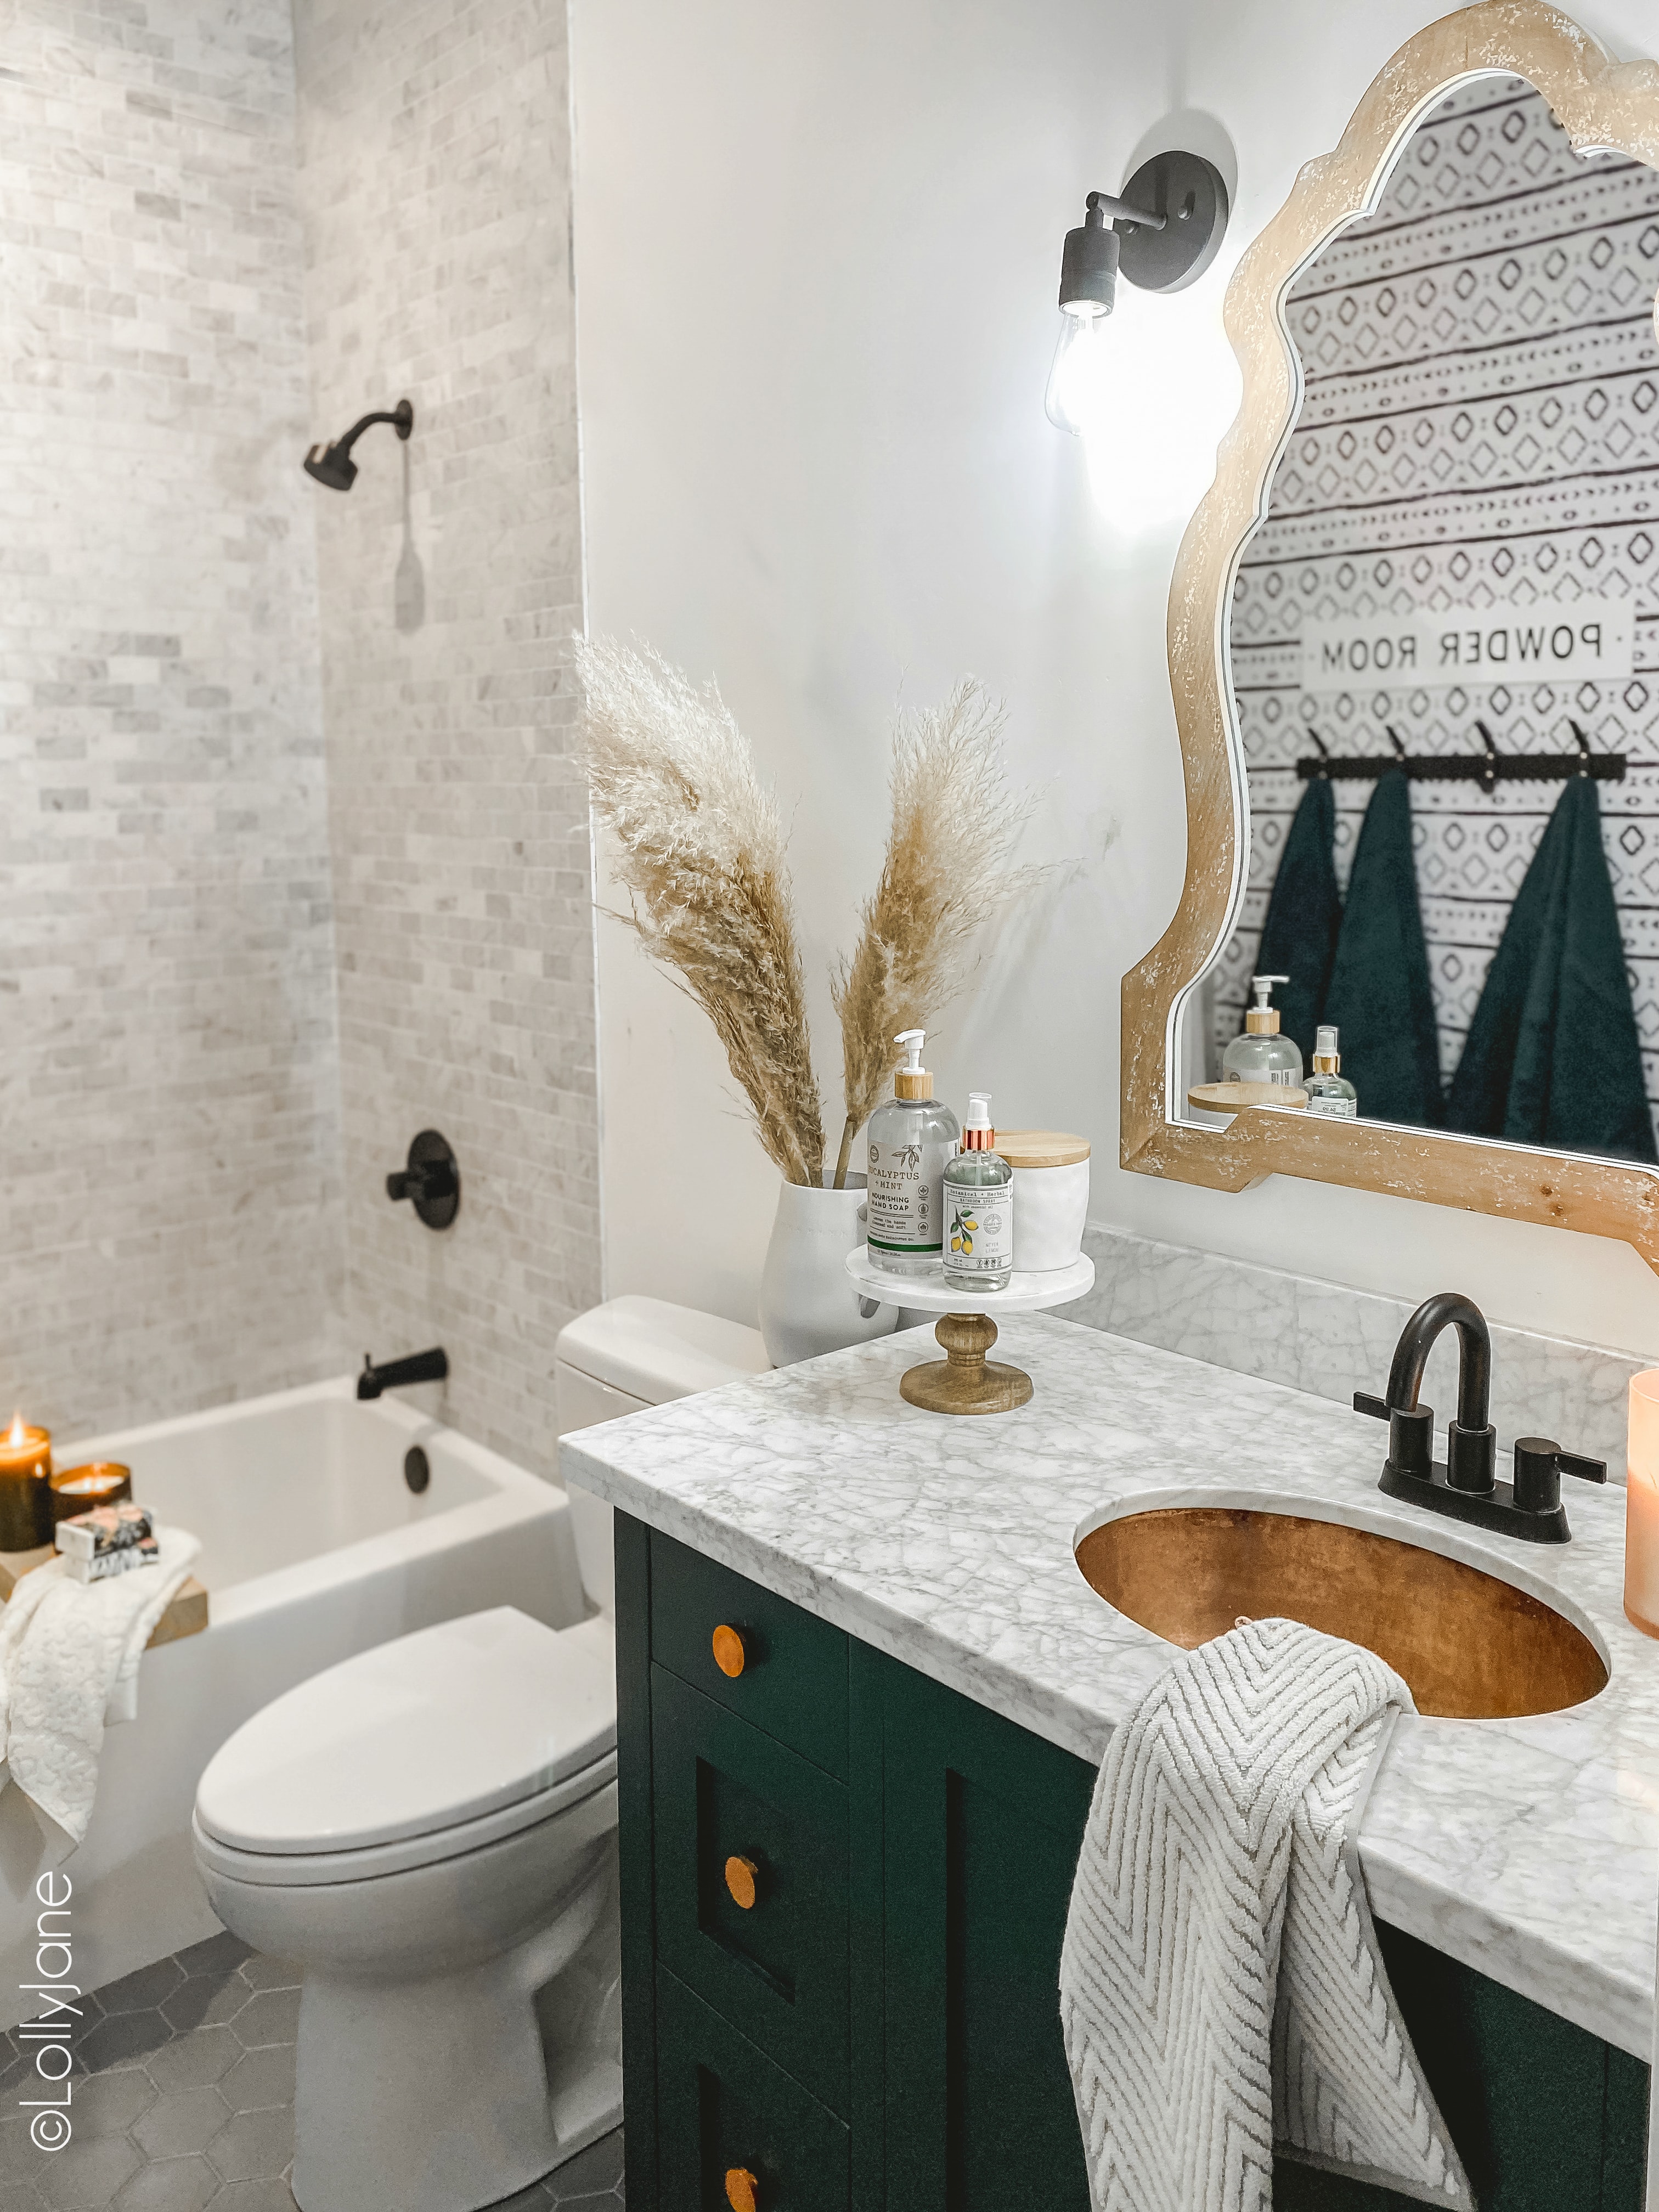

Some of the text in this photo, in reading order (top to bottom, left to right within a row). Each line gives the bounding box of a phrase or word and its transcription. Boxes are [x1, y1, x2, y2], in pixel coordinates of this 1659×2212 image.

[880, 1181, 902, 1190] MINT
[872, 1192, 909, 1203] NOURISHING
[872, 1199, 887, 1209] HAND
